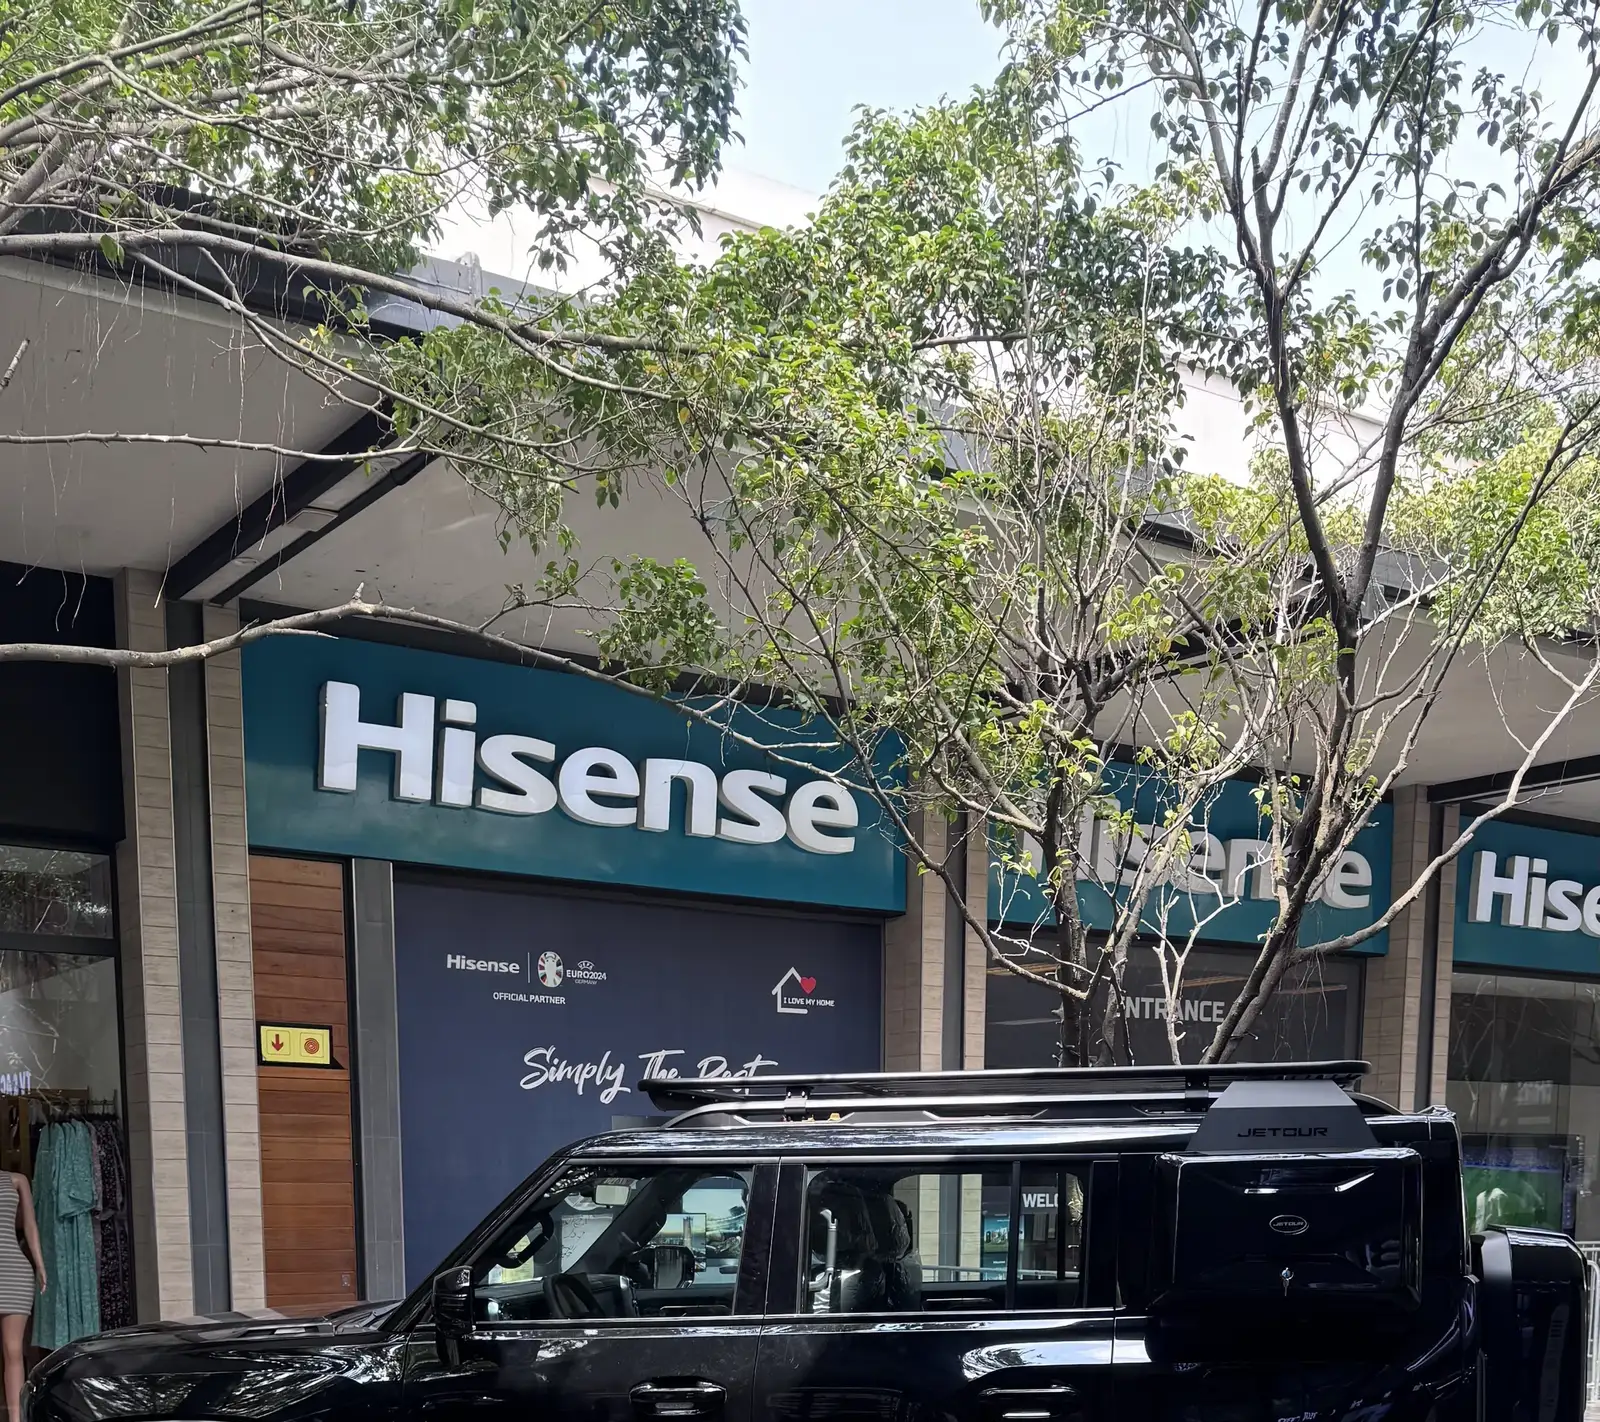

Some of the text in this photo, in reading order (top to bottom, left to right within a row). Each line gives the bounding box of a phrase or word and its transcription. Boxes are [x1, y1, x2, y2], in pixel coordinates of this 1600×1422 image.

[317, 680, 860, 855] Hisense
[1013, 795, 1374, 910] Hisene
[446, 953, 521, 974] Hisense
[493, 992, 566, 1005] OFFICIAL PARTNER
[805, 998, 816, 1006] MY
[1121, 996, 1226, 1022] NTRANCE
[519, 1045, 631, 1104] Simply
[638, 1049, 686, 1080] The
[1237, 1127, 1329, 1138] JETOUR
